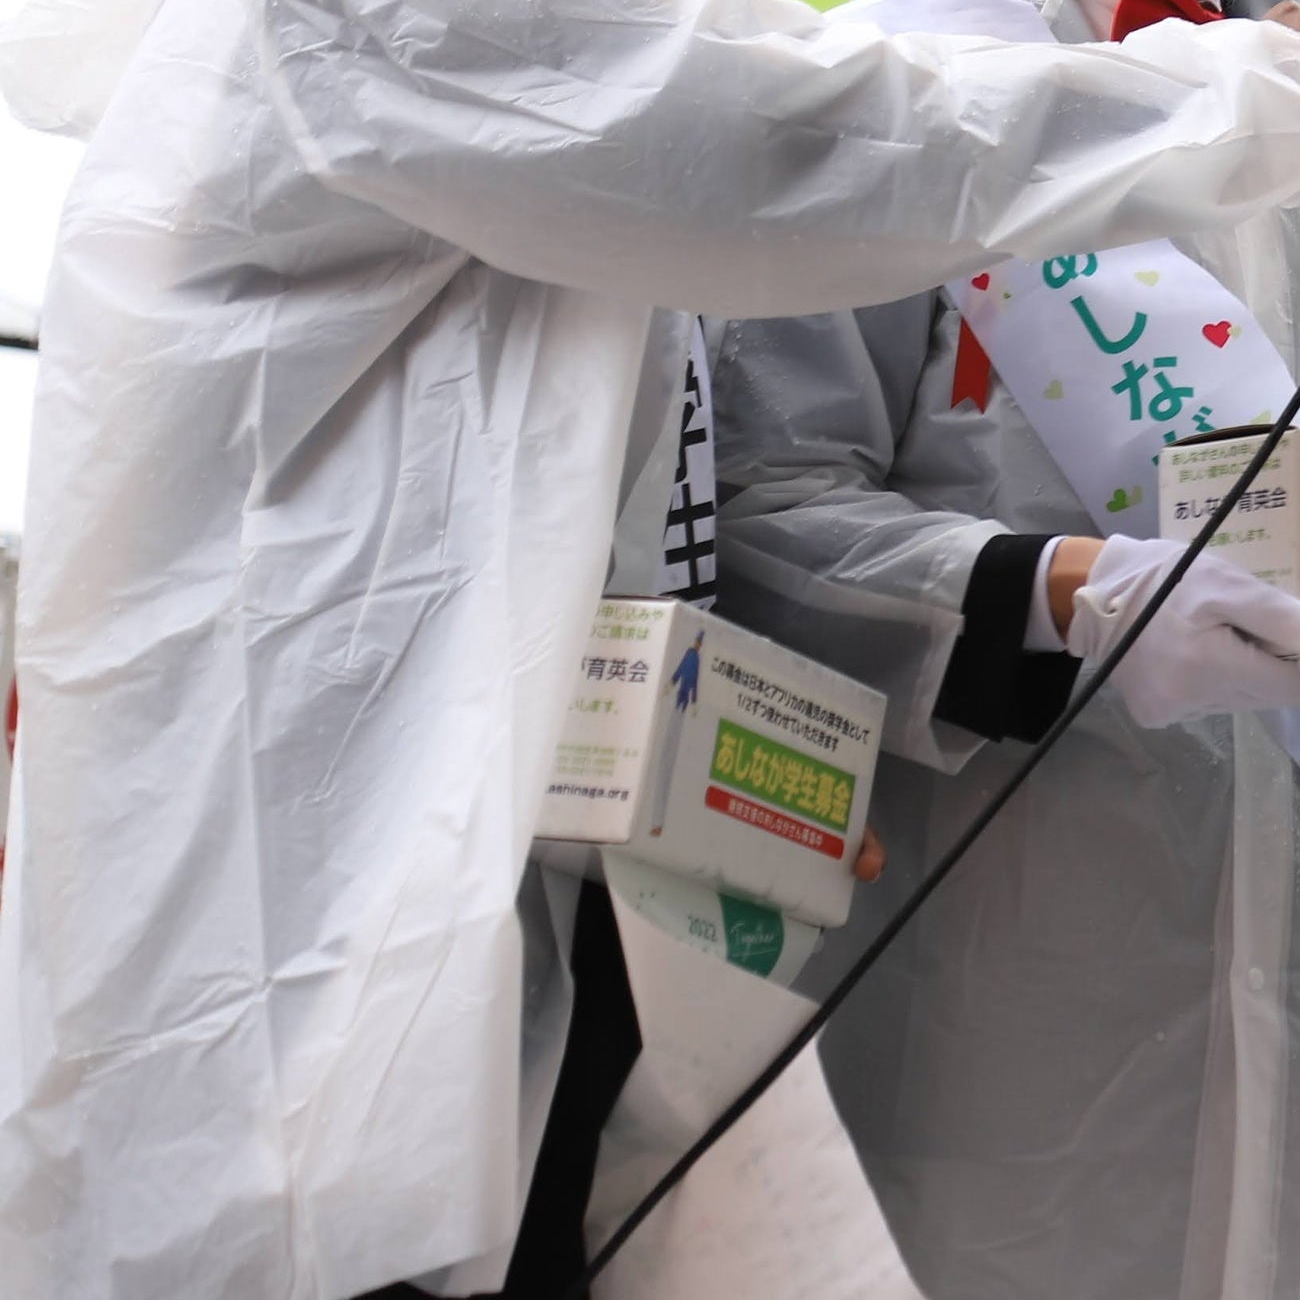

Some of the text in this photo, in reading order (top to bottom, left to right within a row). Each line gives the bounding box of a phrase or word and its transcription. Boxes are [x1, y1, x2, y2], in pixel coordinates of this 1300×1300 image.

[1174, 486, 1288, 520] あしな育英会
[715, 732, 851, 826] あしなが学生募金
